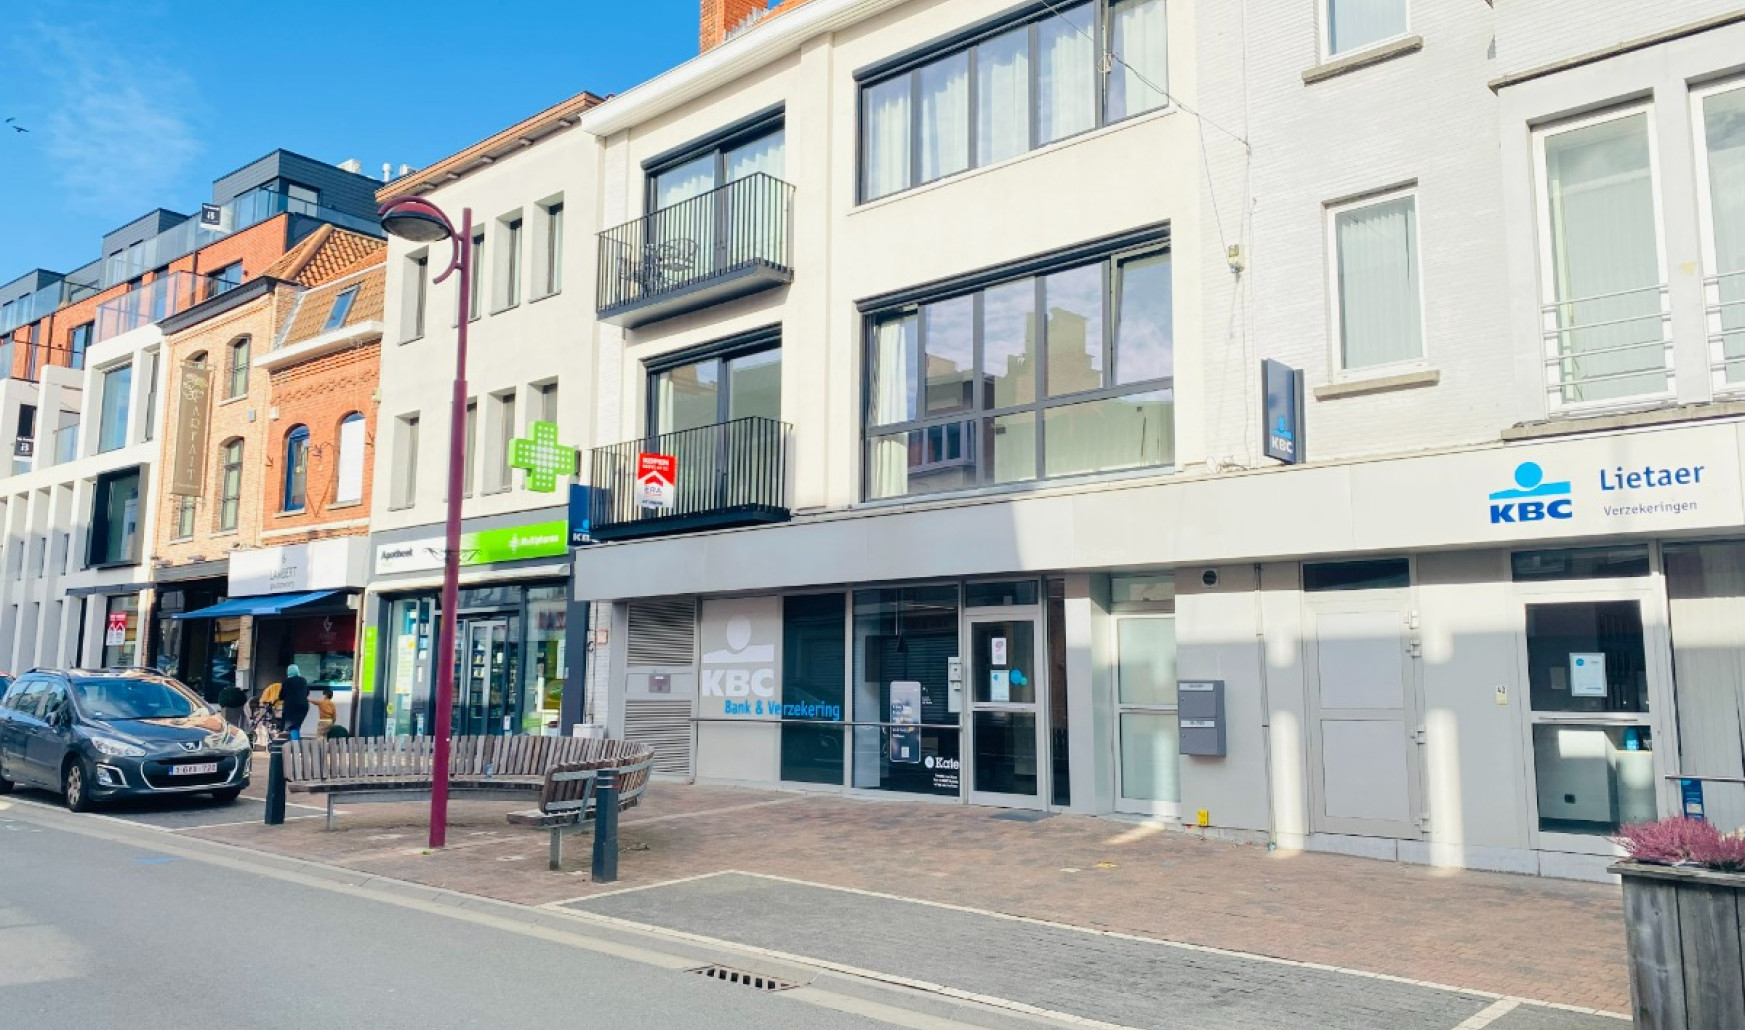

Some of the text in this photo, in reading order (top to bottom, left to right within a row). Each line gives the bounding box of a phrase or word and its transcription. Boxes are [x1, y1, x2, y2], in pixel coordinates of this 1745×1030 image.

[1271, 436, 1294, 454] KBC
[643, 457, 670, 466] KOPEN
[1600, 465, 1705, 491] Lietaer
[1490, 499, 1573, 524] KBC
[1603, 501, 1698, 517] Verzekeringen
[573, 532, 600, 543] KB
[702, 668, 775, 697] KBC
[724, 699, 840, 721] Bank & Verzekering
